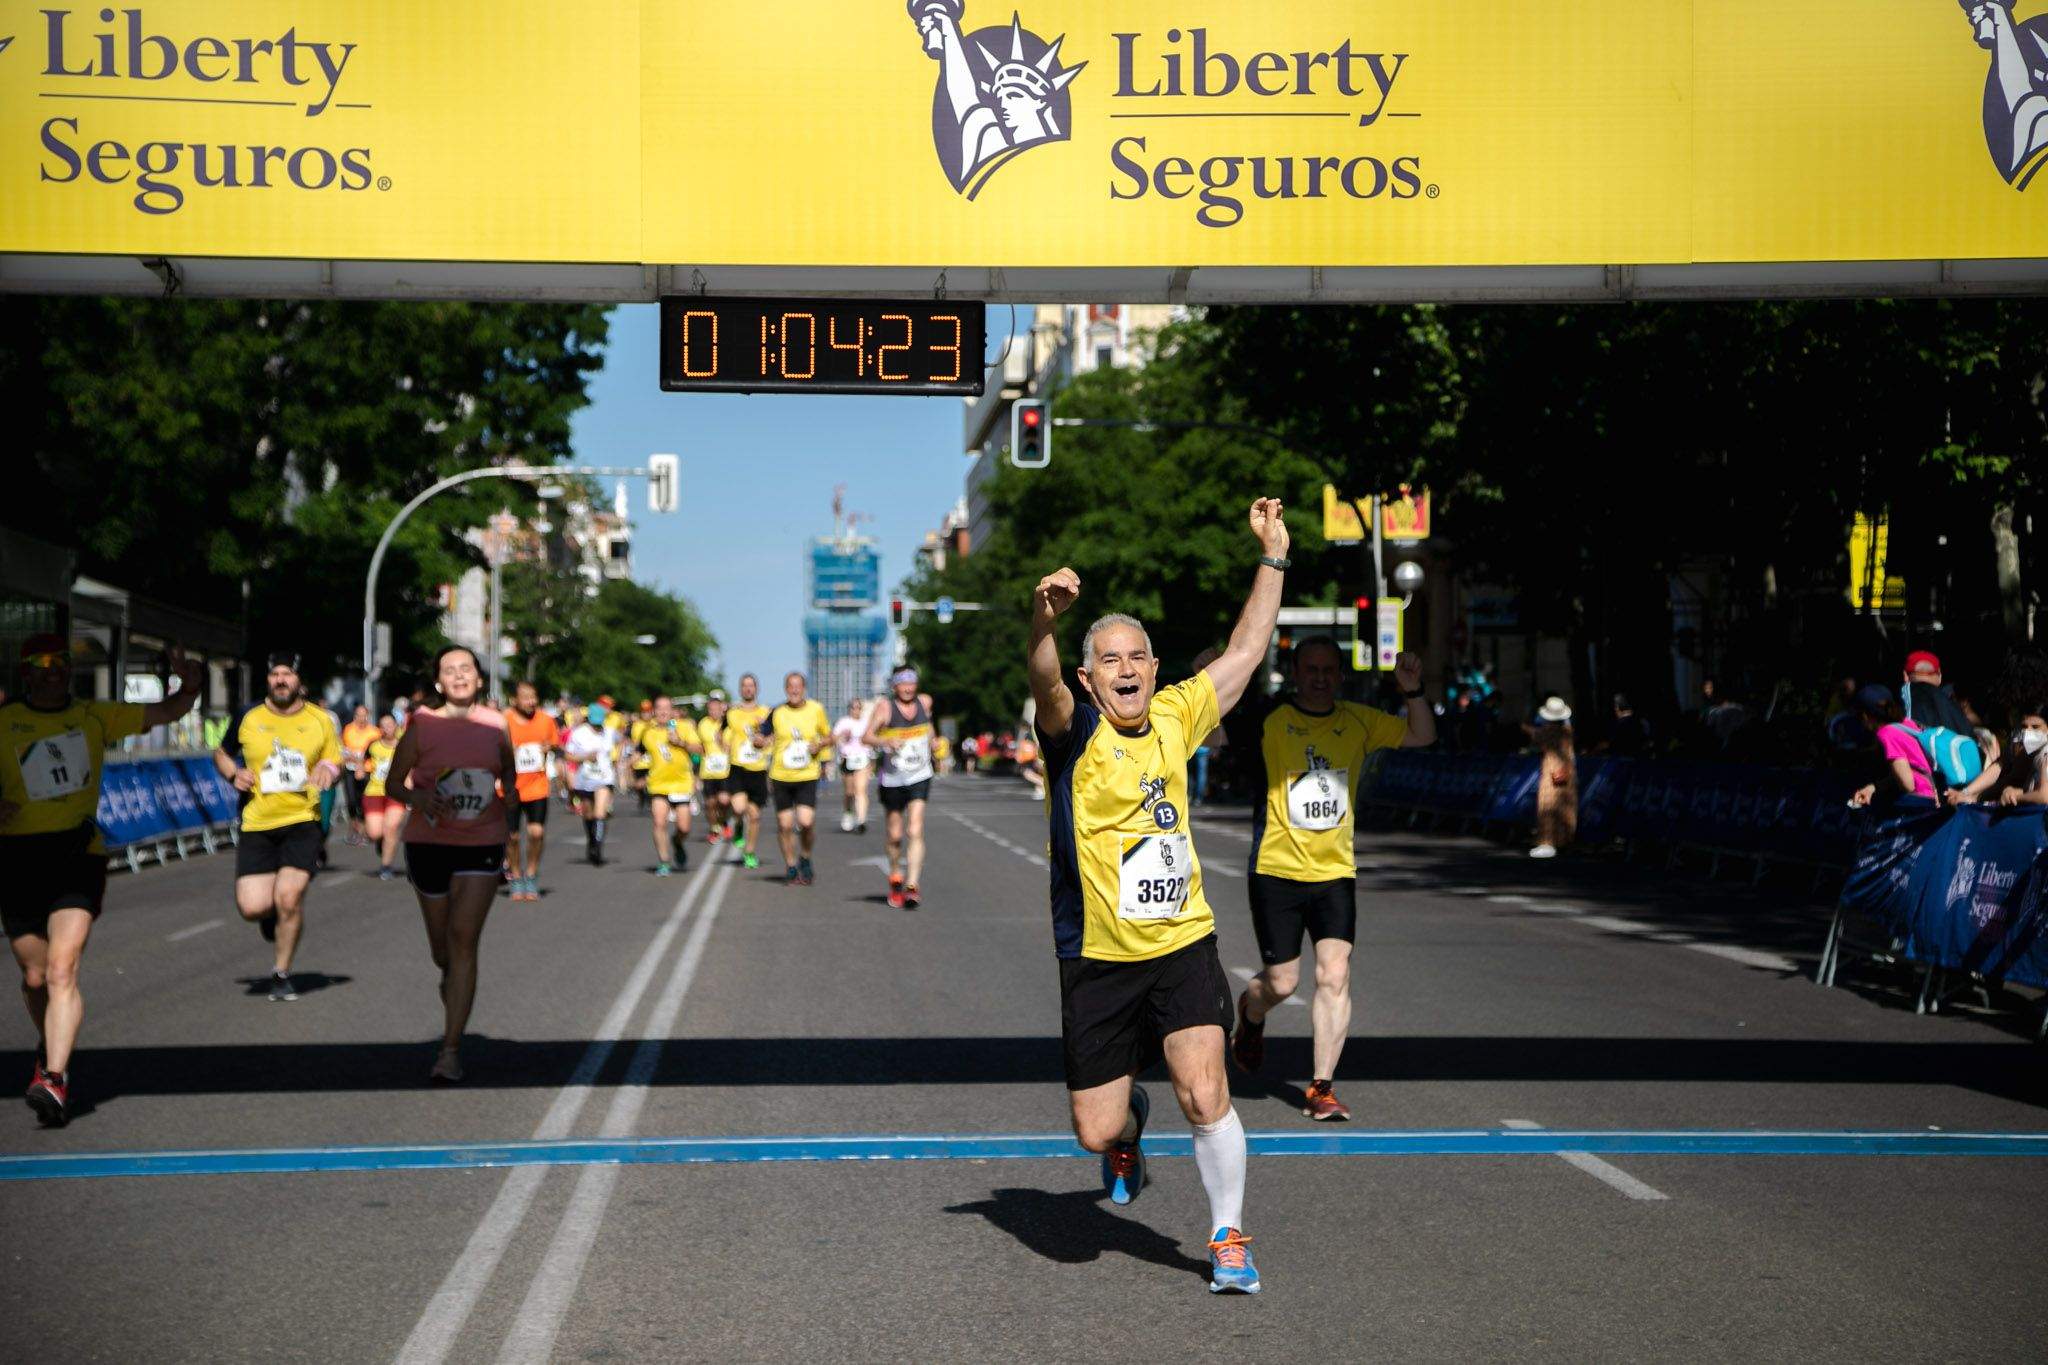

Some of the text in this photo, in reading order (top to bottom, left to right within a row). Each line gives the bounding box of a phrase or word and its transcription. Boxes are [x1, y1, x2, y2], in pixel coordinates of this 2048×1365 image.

[39, 8, 358, 117] Liberty
[1111, 27, 1410, 127] Liberty
[50, 765, 69, 786] 11
[1157, 807, 1175, 824] 13
[1302, 800, 1339, 820] 1864
[1137, 877, 1184, 904] 3522
